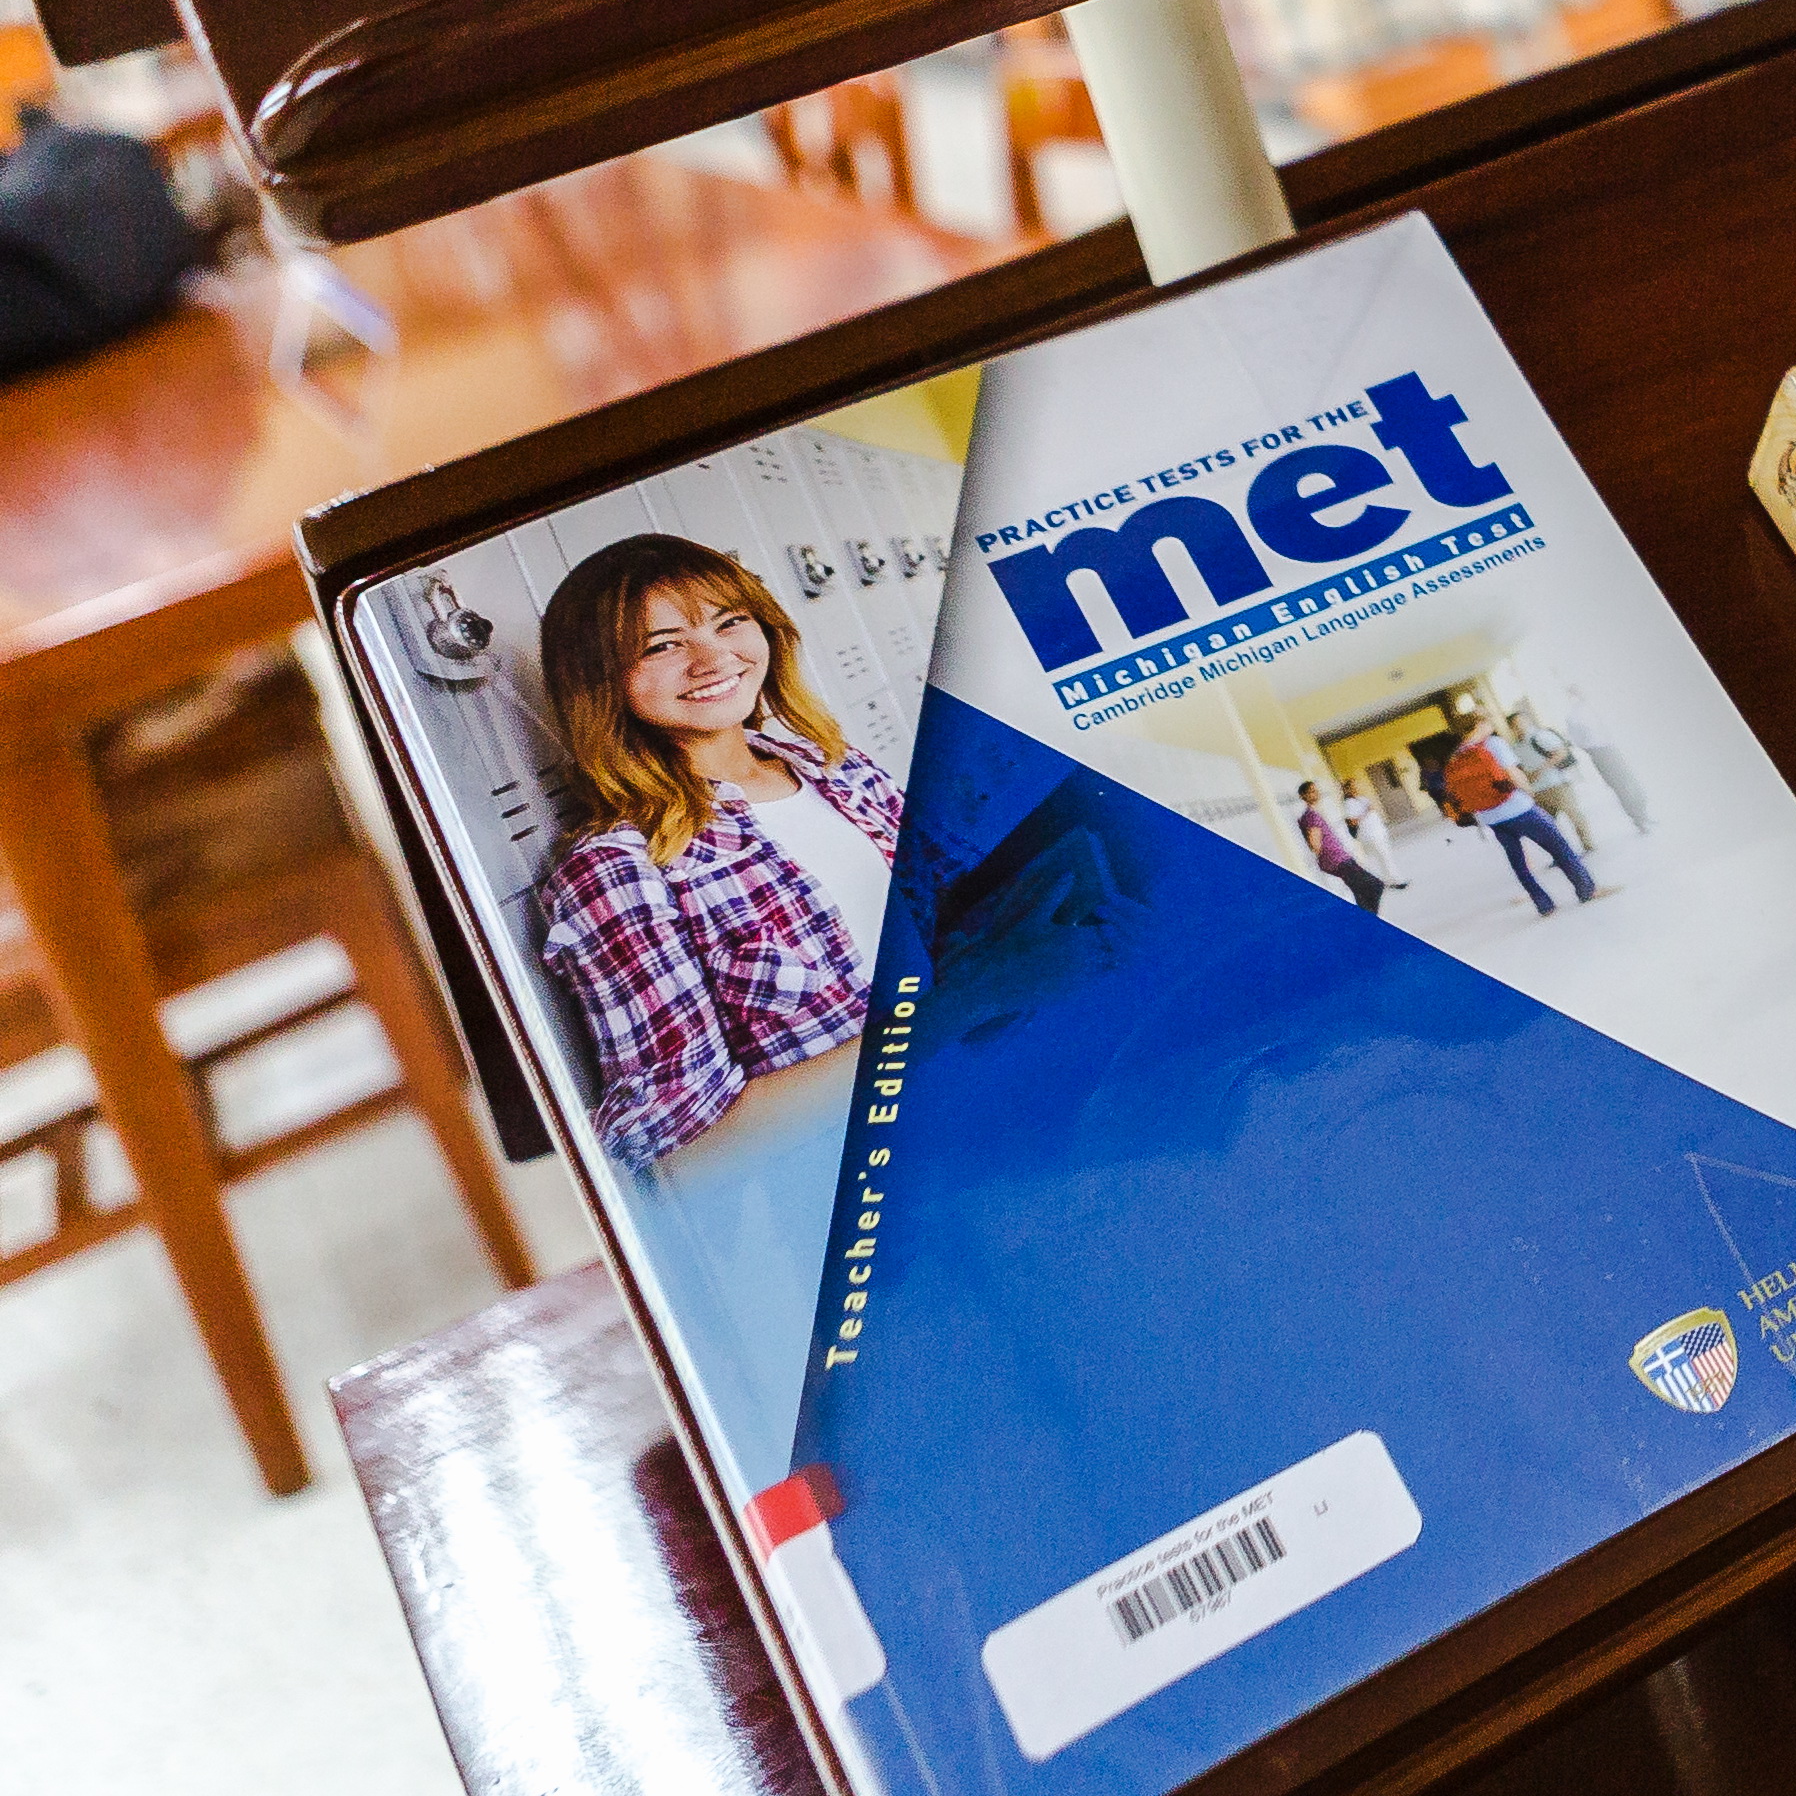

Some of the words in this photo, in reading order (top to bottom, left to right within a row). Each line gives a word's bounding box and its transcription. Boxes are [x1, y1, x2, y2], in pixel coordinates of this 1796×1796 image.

[975, 484, 1135, 554] PRACTICE
[1140, 448, 1236, 496] TESTS
[1240, 425, 1306, 460] FOR
[1311, 400, 1368, 435] THE
[987, 370, 1515, 674] met
[1060, 613, 1254, 707] Michigan
[1269, 554, 1425, 625] English
[1439, 510, 1529, 556] Test
[1072, 671, 1198, 732] Cambridge
[1199, 632, 1301, 683] Michigan
[1303, 590, 1408, 642] Language
[1410, 534, 1547, 606] Assessments
[824, 1147, 892, 1372] Teacher's
[867, 975, 922, 1126] Edition
[1192, 1524, 1214, 1546] for
[1241, 1489, 1275, 1518] MET
